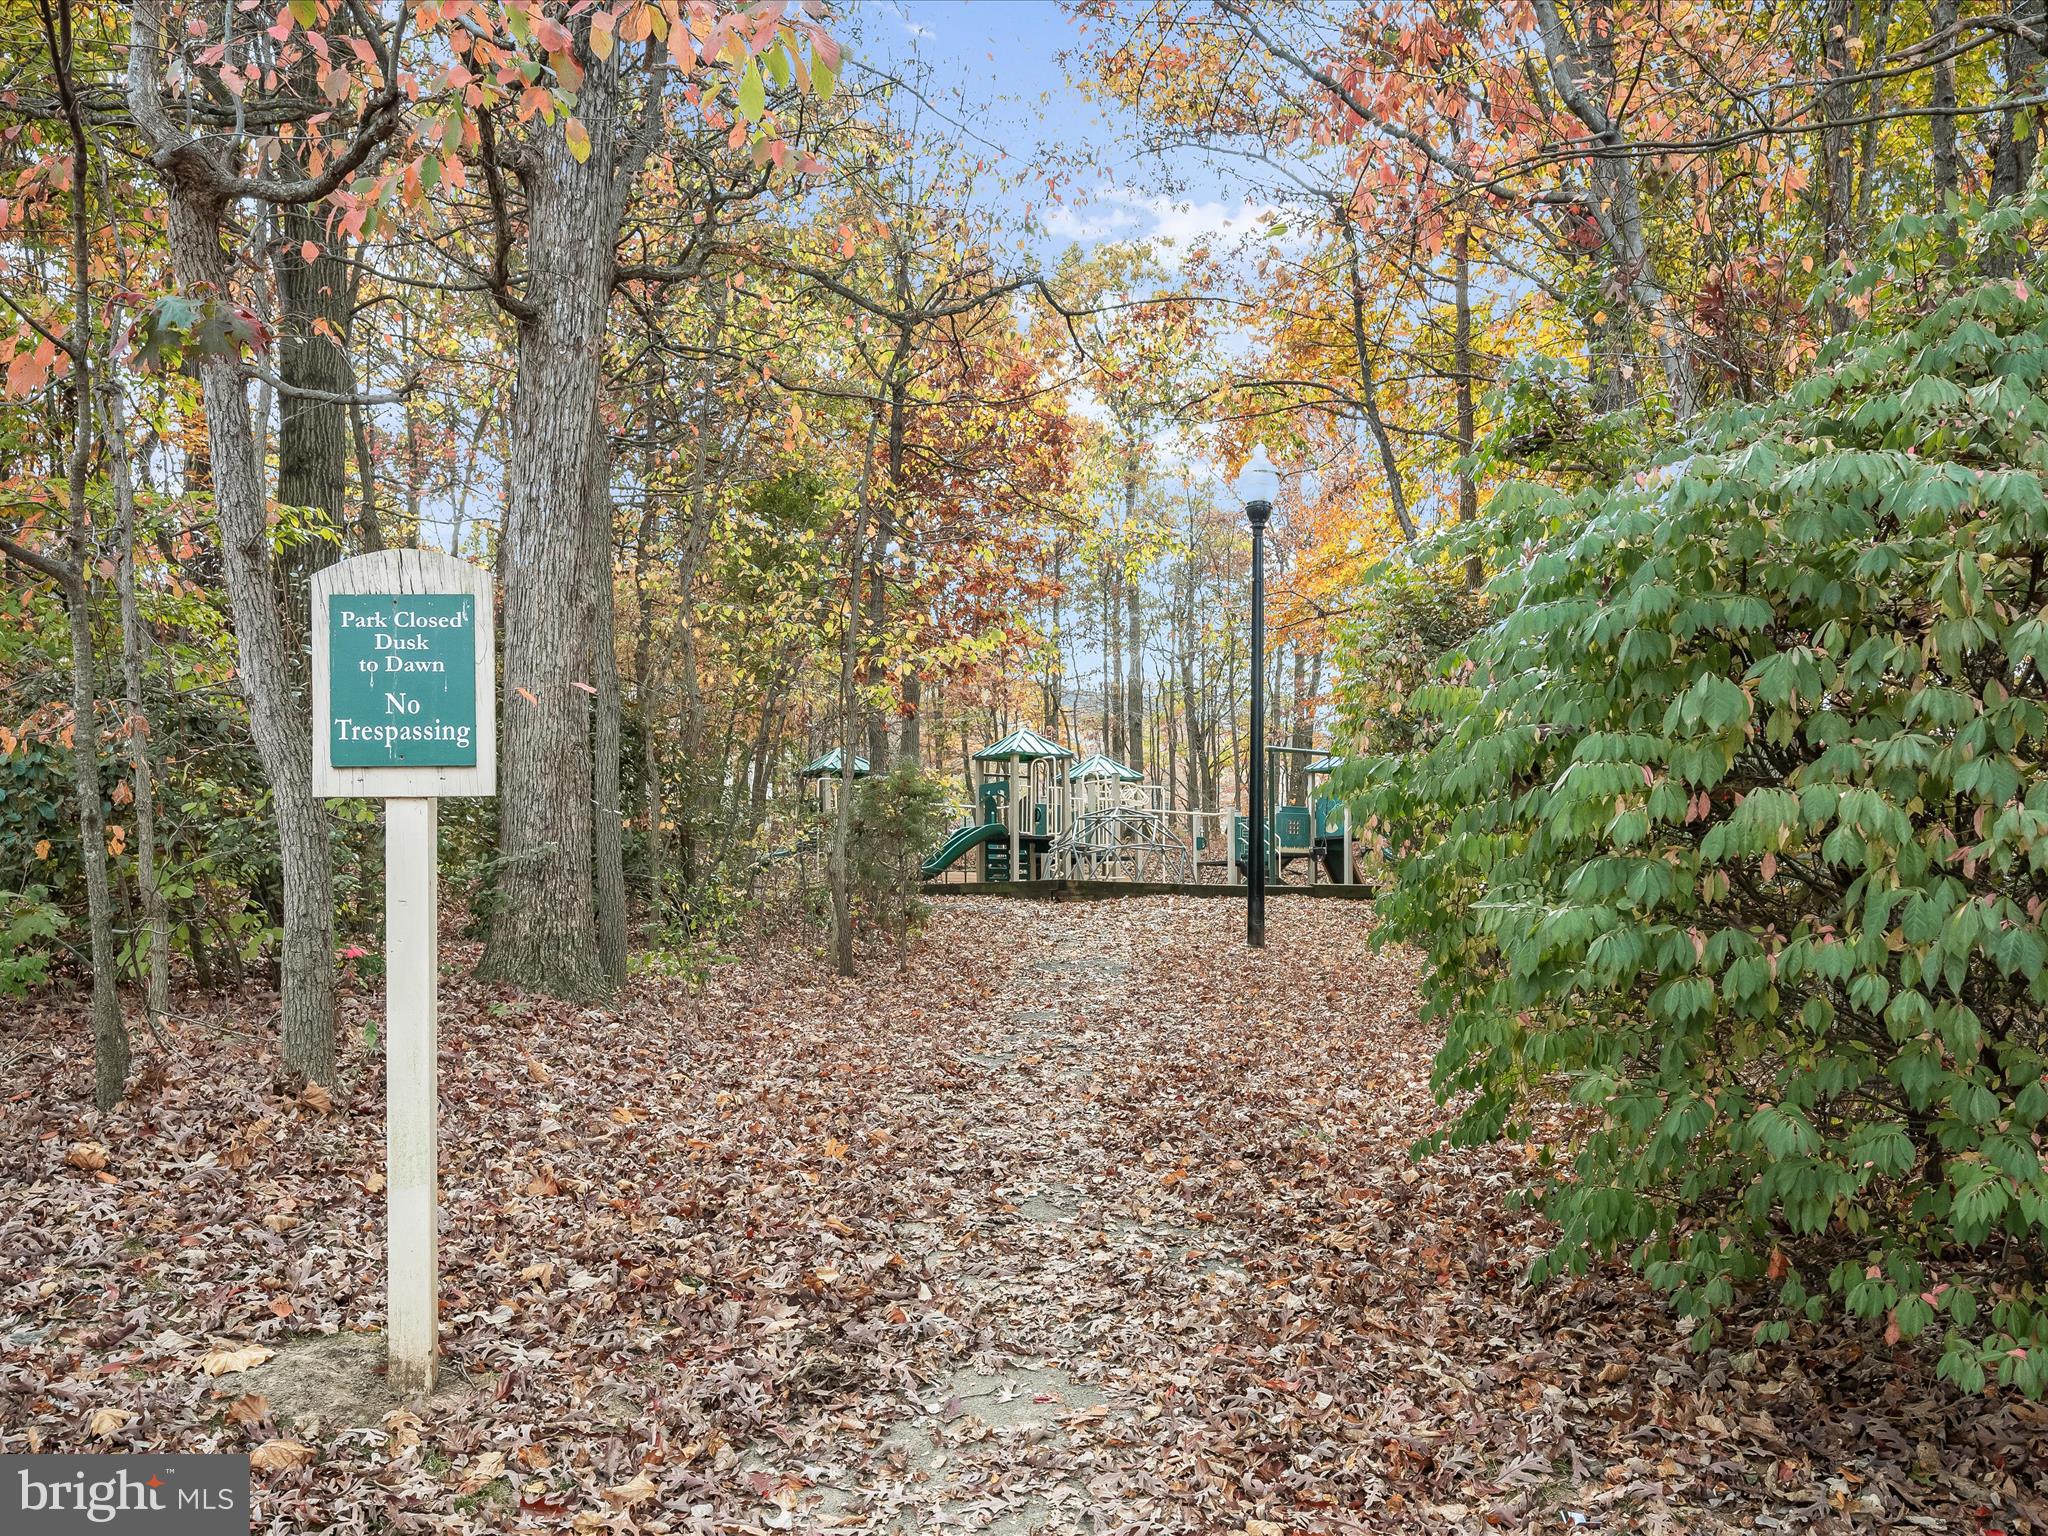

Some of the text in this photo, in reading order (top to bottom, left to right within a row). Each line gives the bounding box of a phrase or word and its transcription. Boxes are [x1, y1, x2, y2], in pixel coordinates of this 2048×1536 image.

[340, 611, 463, 628] Park Closed
[374, 633, 429, 651] Dusk
[359, 656, 445, 673] to Dawn
[384, 693, 421, 715] No
[334, 718, 471, 748] Trespassing
